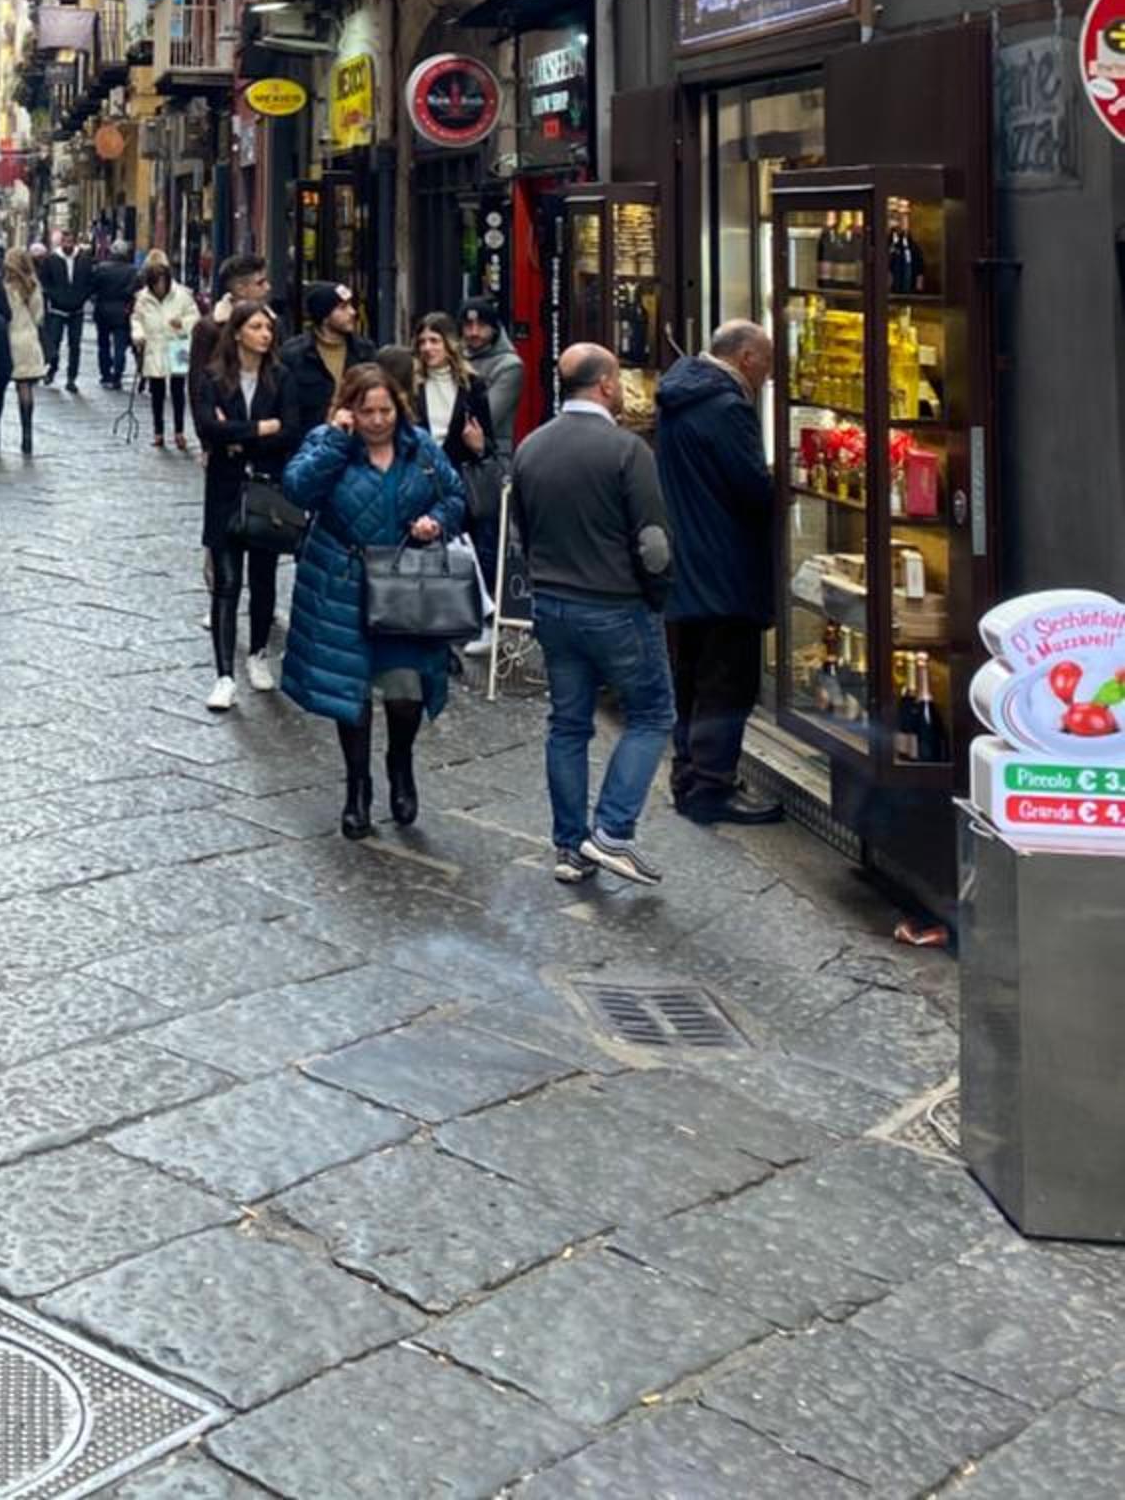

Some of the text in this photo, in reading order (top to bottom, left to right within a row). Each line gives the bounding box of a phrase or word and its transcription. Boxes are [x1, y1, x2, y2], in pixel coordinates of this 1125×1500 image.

[1015, 766, 1072, 790] Piccolo
[1078, 769, 1098, 791] €
[1017, 799, 1075, 822] Grande
[1079, 801, 1099, 824] €
